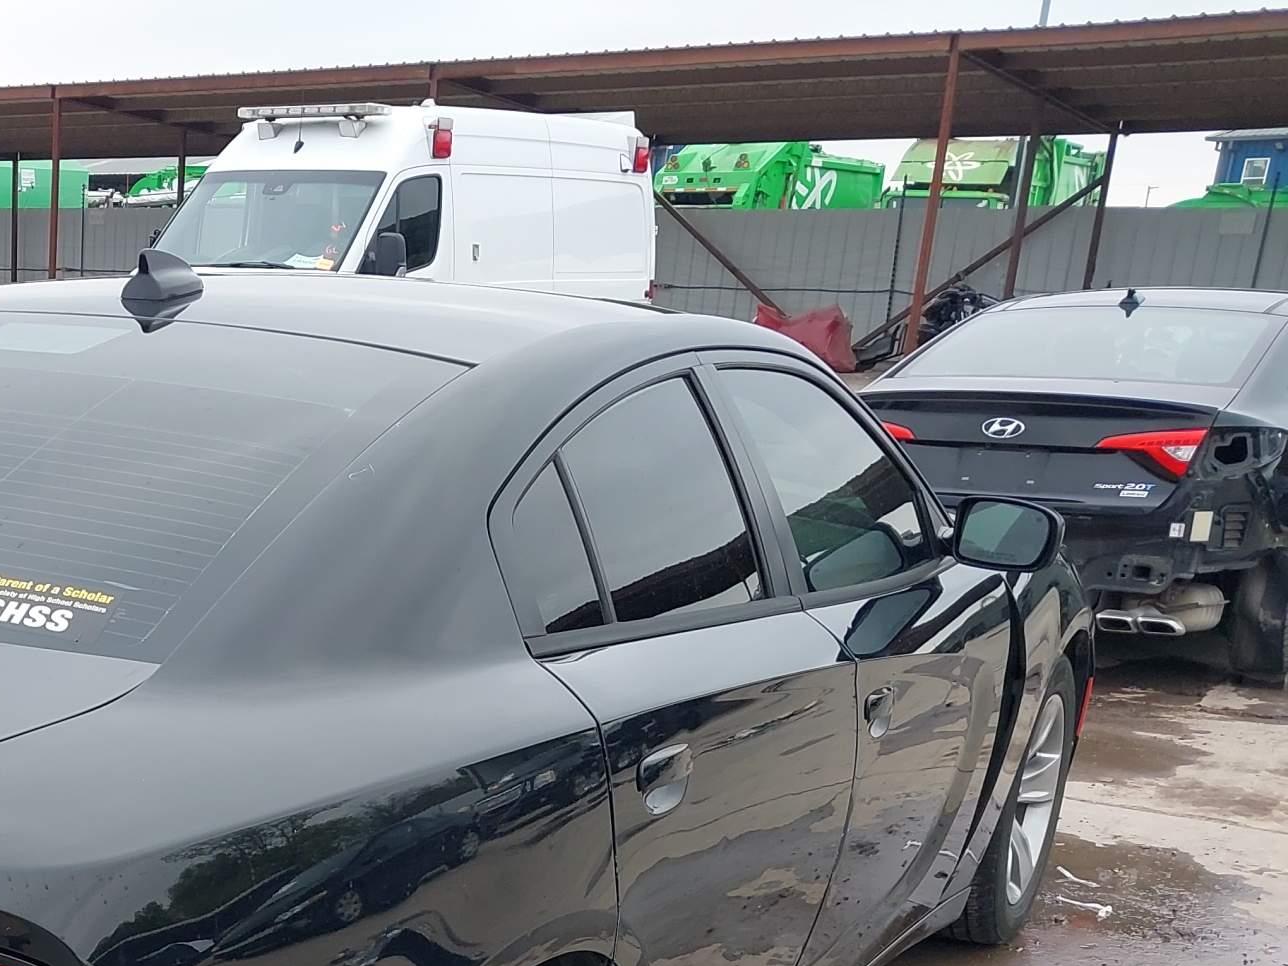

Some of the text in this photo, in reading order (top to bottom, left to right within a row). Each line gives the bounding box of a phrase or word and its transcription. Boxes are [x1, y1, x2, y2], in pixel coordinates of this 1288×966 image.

[19, 591, 28, 599] of
[28, 593, 45, 603] High
[46, 596, 72, 607] School
[73, 601, 107, 614] Scholars
[35, 583, 49, 593] of
[51, 587, 60, 595] a
[63, 586, 114, 604] Scholar
